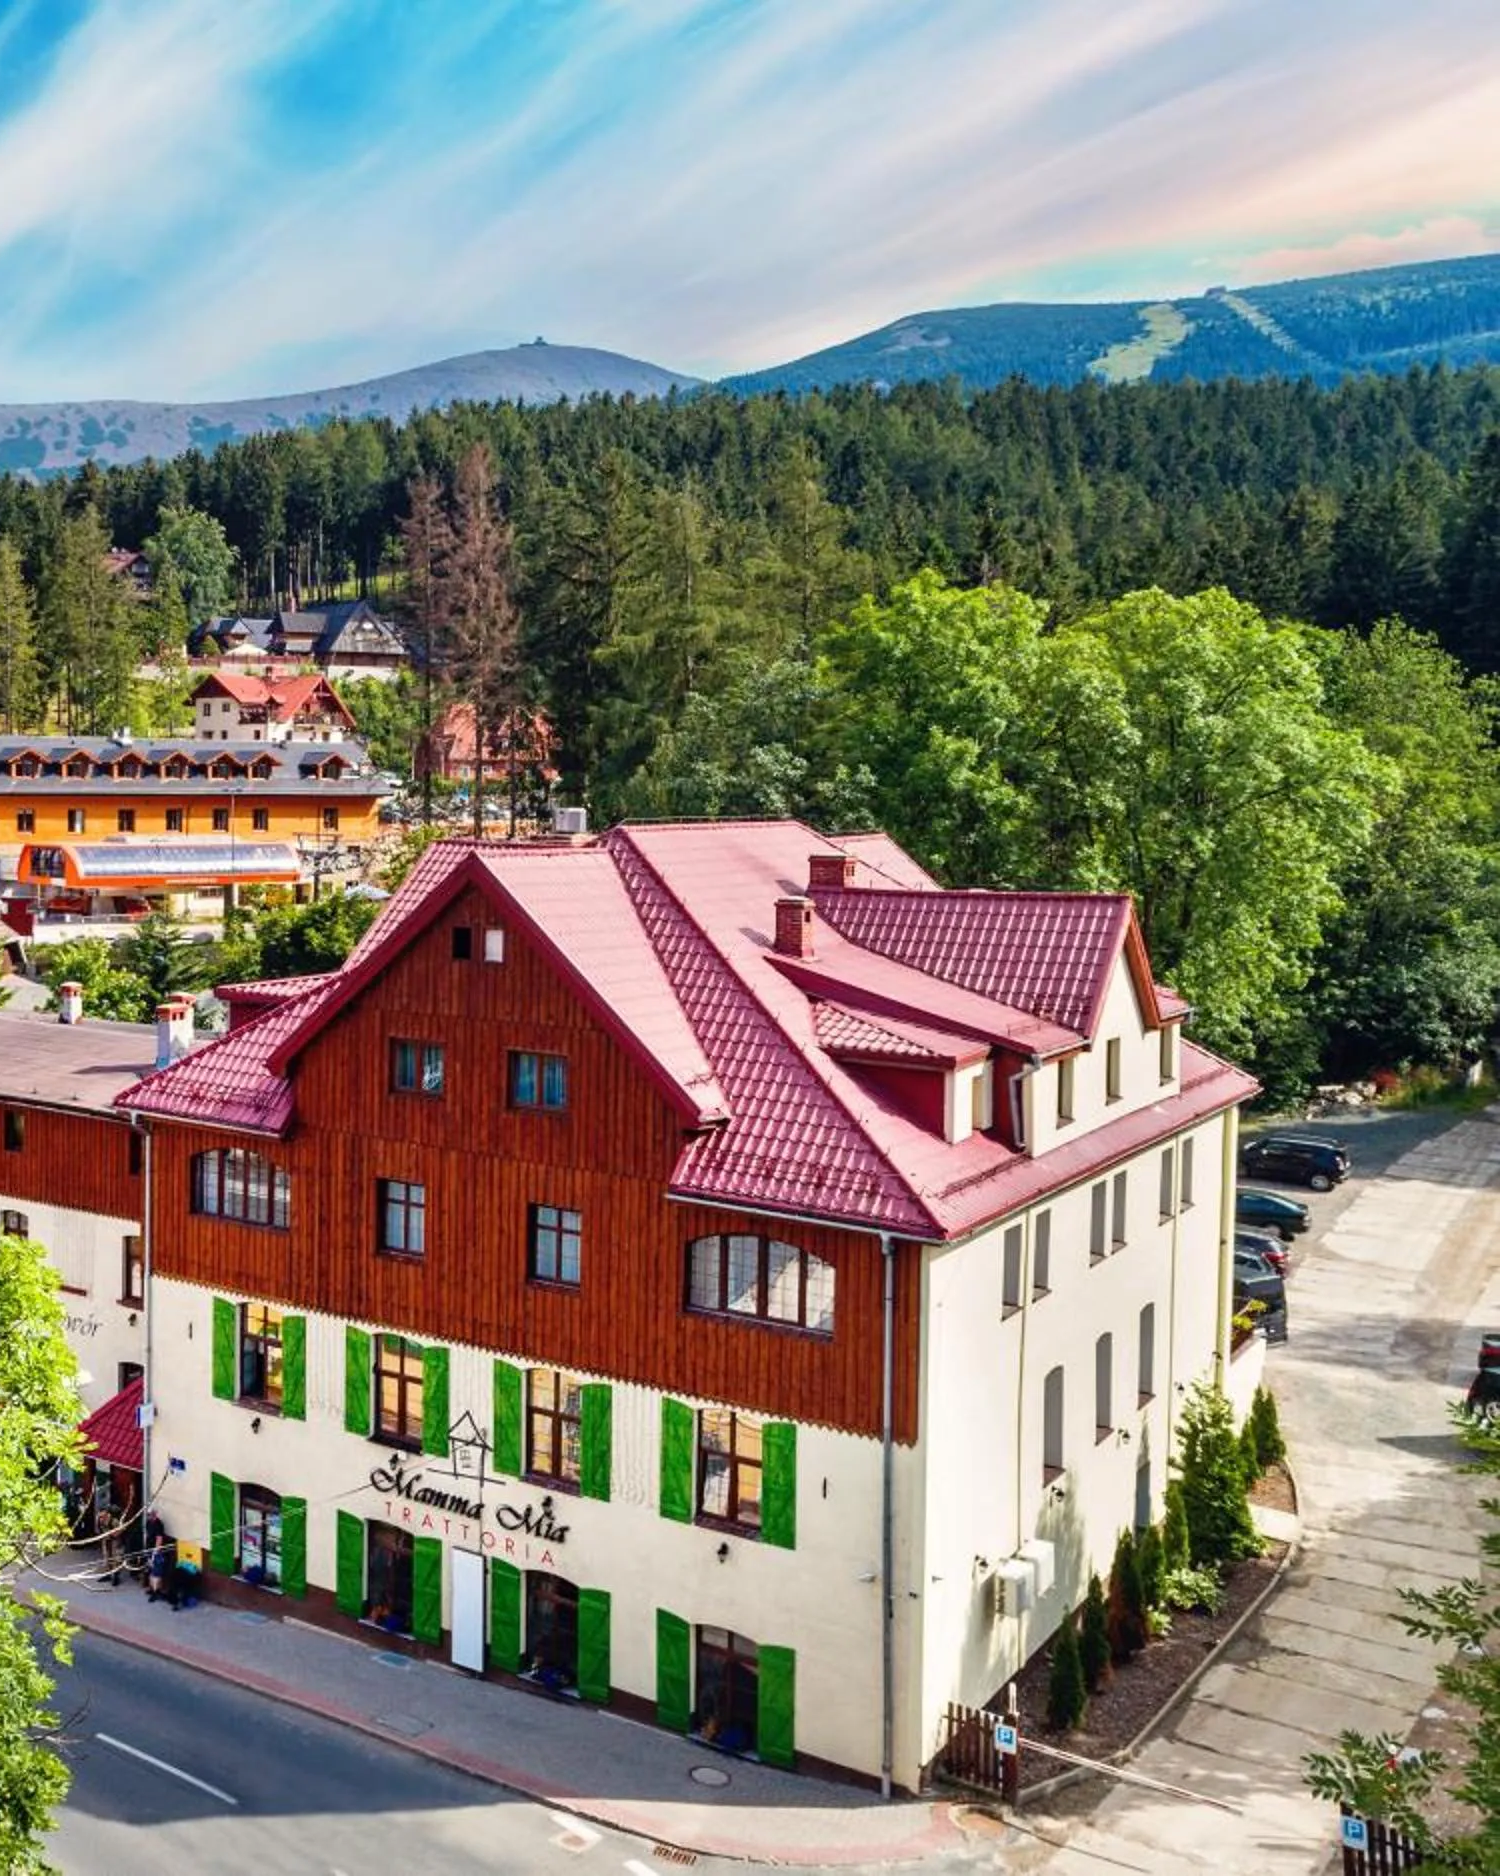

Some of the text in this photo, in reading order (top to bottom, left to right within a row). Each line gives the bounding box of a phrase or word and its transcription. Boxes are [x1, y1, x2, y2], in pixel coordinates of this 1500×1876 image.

[370, 1465, 572, 1544] Mamma Mia
[385, 1501, 556, 1567] TRATTORIA
